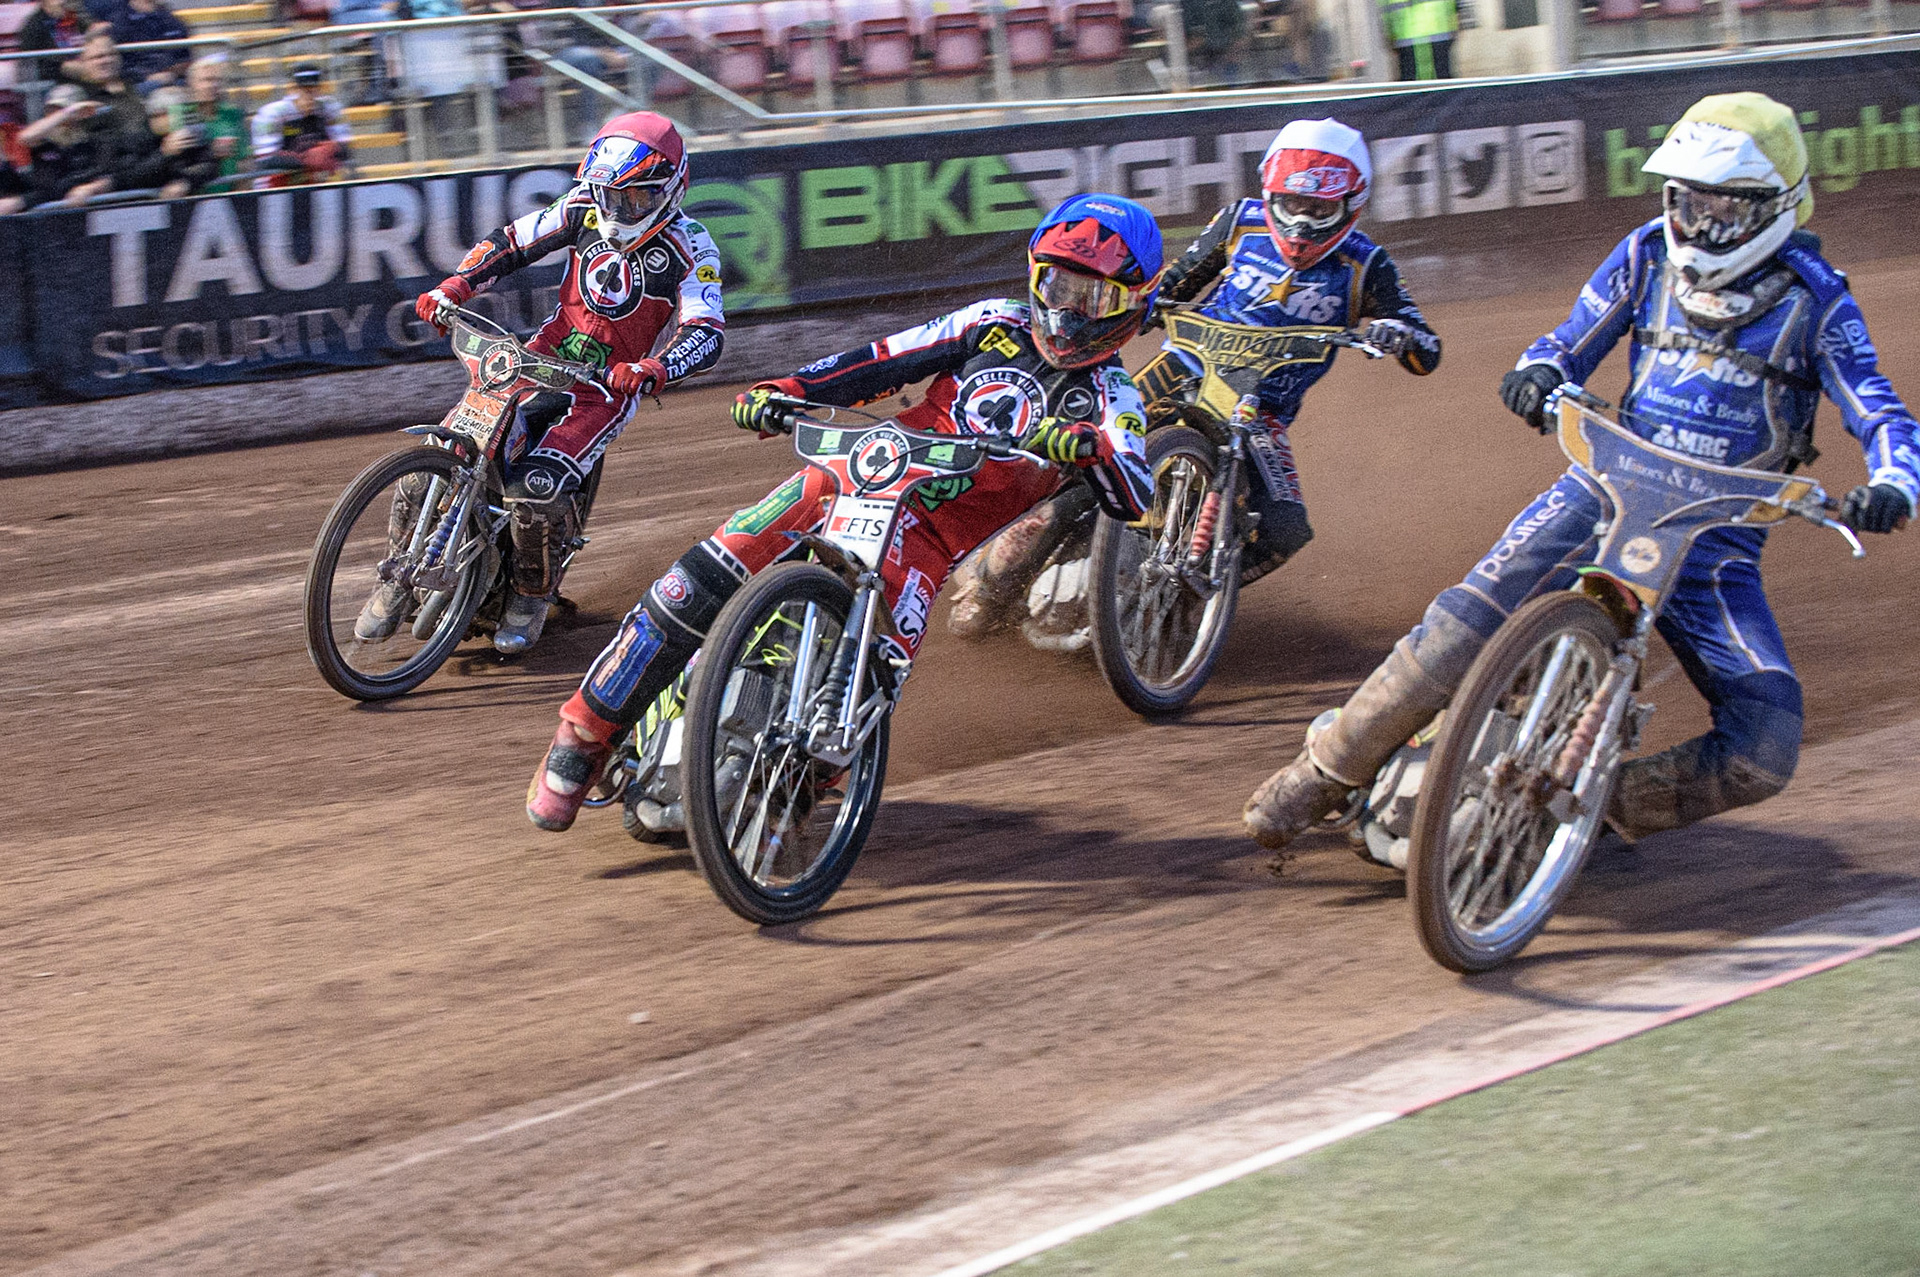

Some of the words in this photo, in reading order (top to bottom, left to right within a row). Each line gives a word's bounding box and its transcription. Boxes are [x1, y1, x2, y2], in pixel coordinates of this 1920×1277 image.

[86, 168, 578, 308] TAURUS
[630, 261, 642, 287] ACES
[92, 303, 375, 380] SECURITY
[667, 328, 709, 365] PREMIER
[666, 334, 719, 380] TRANSPORT
[974, 372, 1013, 387] BELLE
[1016, 376, 1038, 398] VUE
[1643, 384, 1692, 411] Minors
[1693, 394, 1713, 417] &
[454, 413, 493, 436] PREMIER
[854, 433, 877, 453] BELLE
[879, 432, 895, 440] VUE
[1676, 428, 1730, 458] MRC
[846, 517, 886, 537] FTS
[664, 576, 683, 597] STS
[898, 592, 928, 648] FTS
